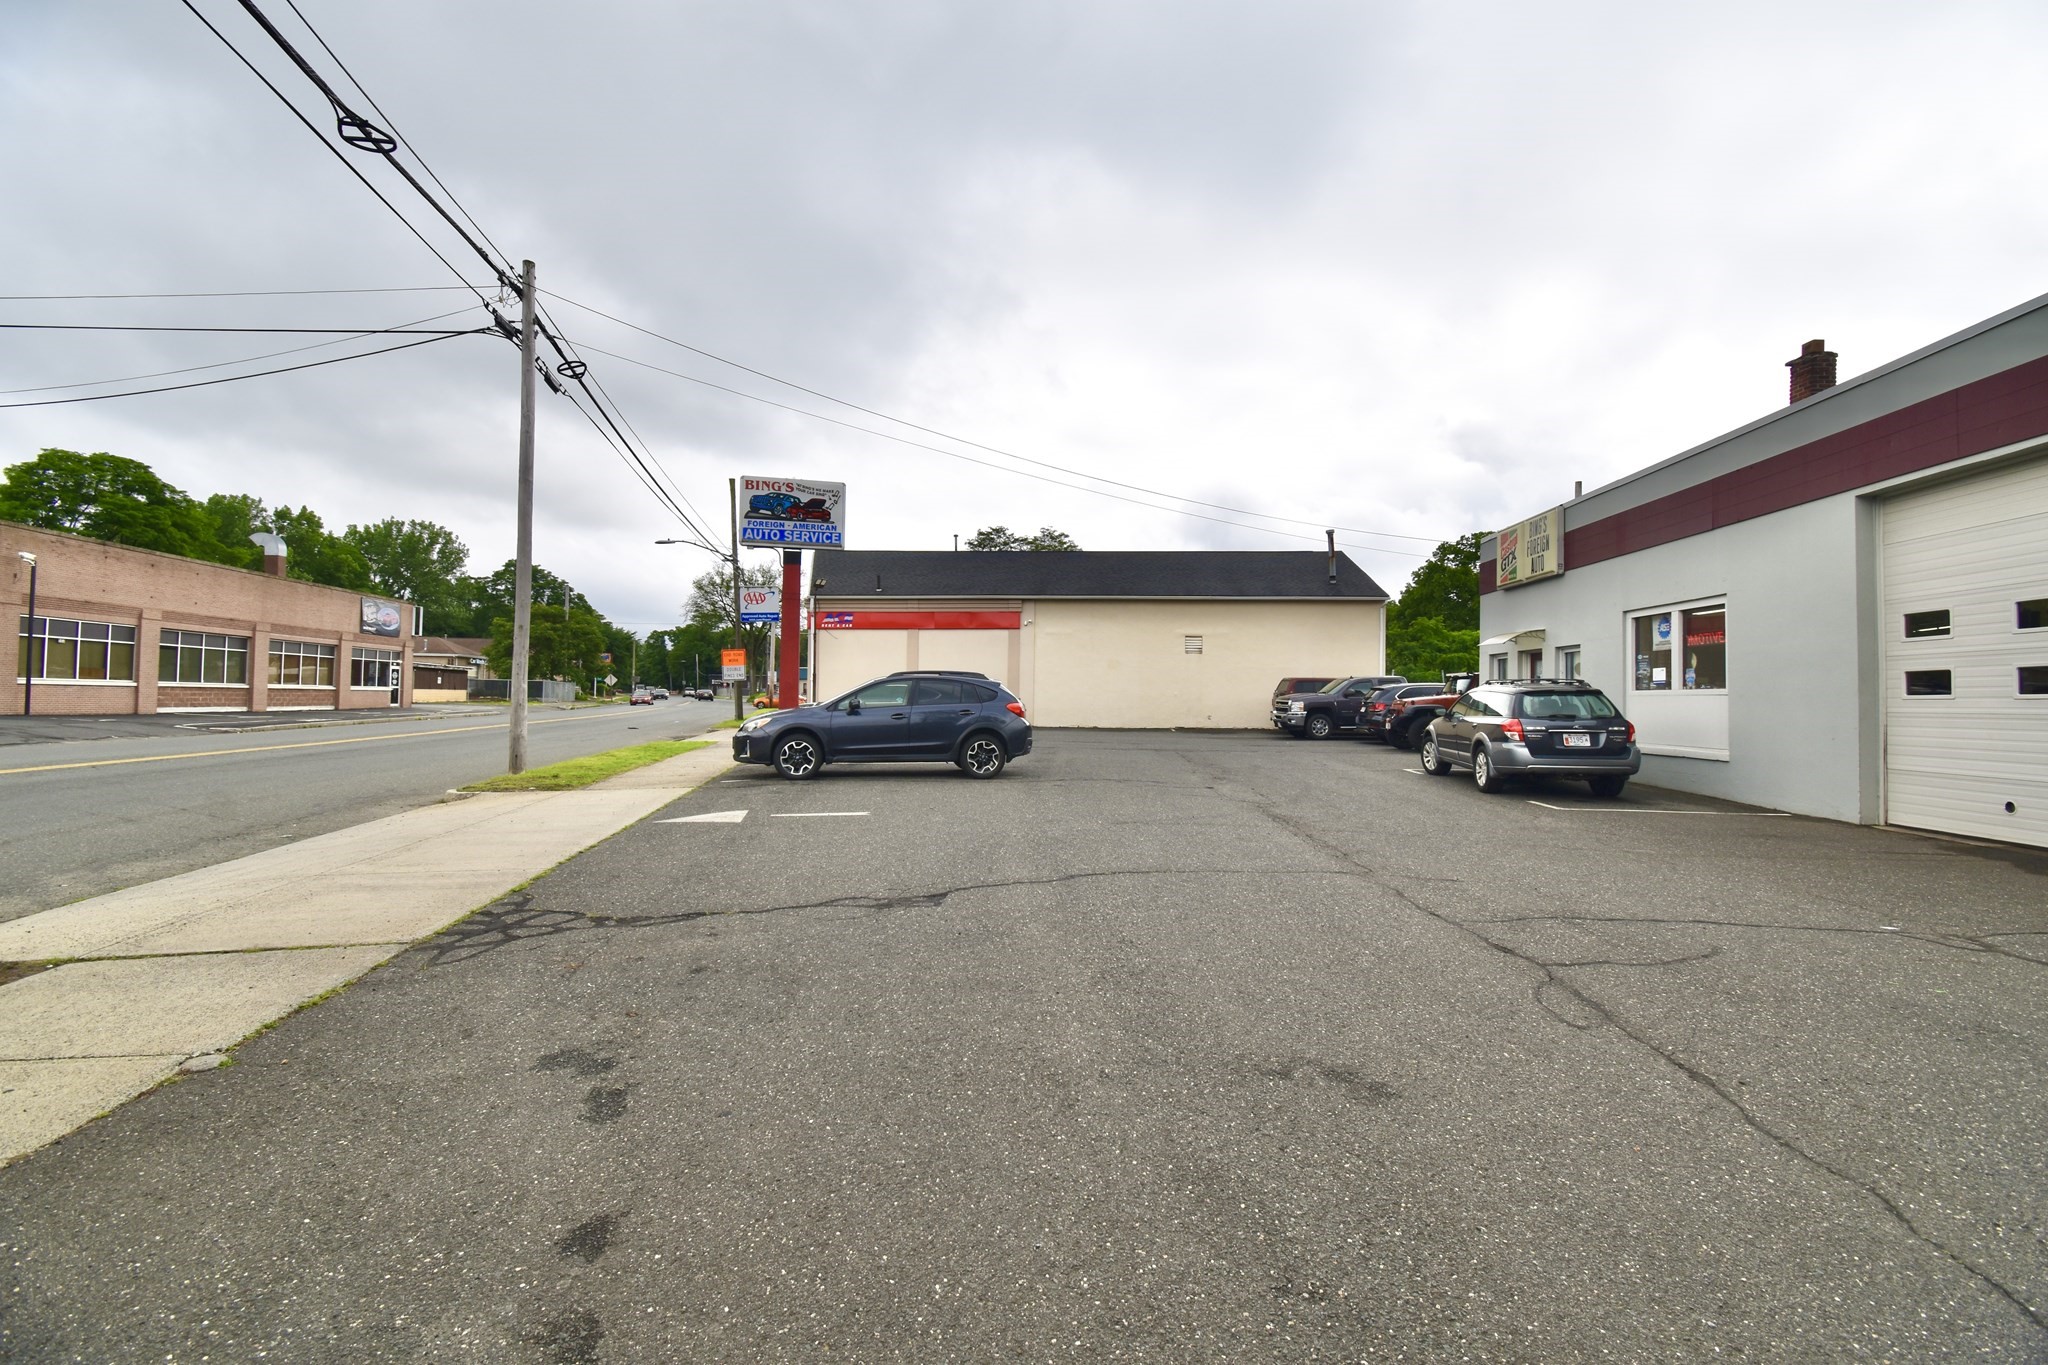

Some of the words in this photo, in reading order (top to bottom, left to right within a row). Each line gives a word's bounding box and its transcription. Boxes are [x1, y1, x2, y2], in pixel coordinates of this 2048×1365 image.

[745, 480, 794, 492] BING'S
[748, 520, 785, 529] FOREIGN
[793, 523, 837, 531] AMERICAN
[1529, 516, 1547, 539] BING'S
[744, 528, 780, 540] AUTO
[784, 531, 840, 544] SERVICE
[1527, 534, 1550, 558] FOREIGN
[1501, 547, 1517, 572] GTX
[1531, 554, 1545, 575] AUTO
[745, 592, 766, 604] AAA
